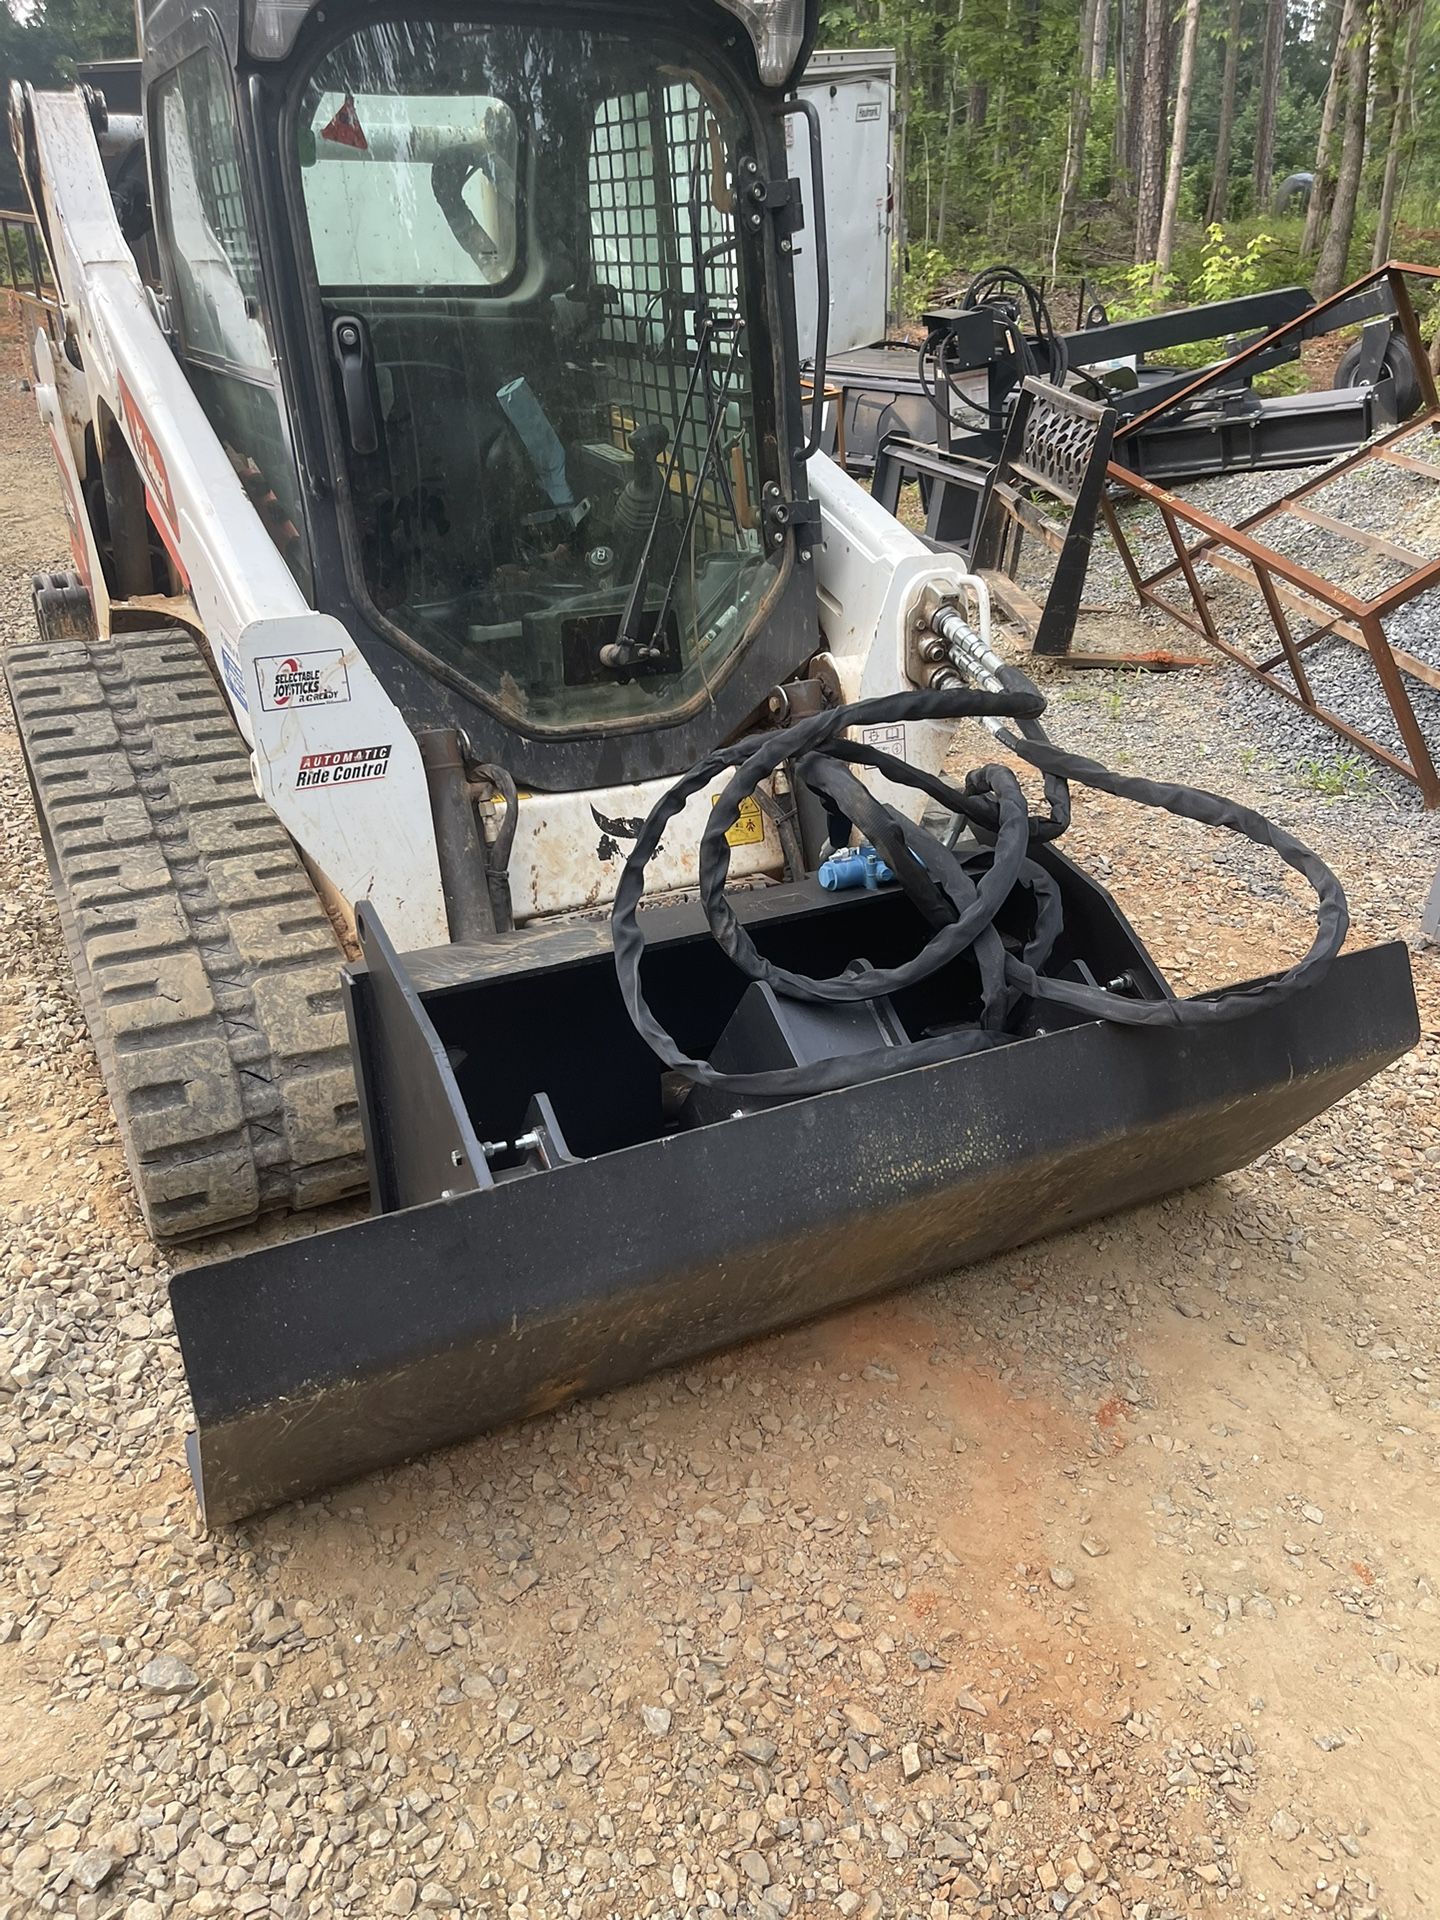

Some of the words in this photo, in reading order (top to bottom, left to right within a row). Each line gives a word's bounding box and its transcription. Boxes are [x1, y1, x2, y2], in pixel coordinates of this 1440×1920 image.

[275, 670, 320, 684] SELECTABLE
[273, 681, 319, 697] JOYSTICKS
[302, 747, 388, 768] AUTOMATIC
[296, 769, 329, 787] Ride
[333, 760, 388, 781] Control
